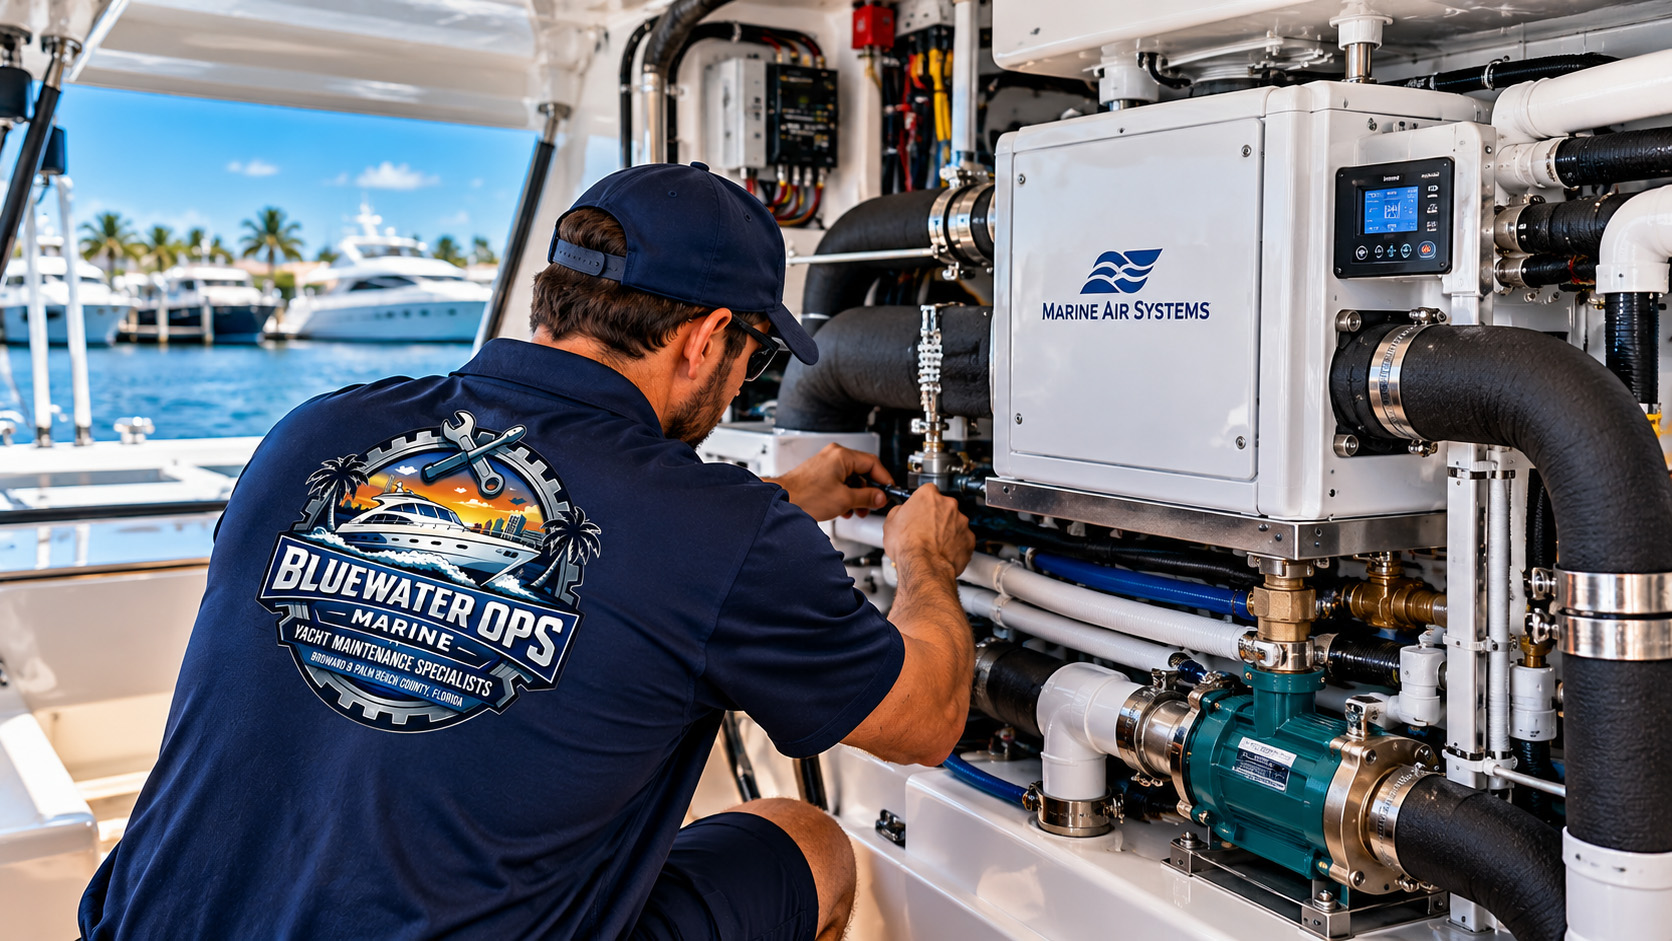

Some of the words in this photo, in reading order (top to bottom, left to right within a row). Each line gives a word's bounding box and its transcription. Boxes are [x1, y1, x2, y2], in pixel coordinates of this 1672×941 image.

[1042, 302, 1098, 320] MARINE
[1102, 301, 1130, 320] AIR
[1134, 300, 1210, 320] SYSTEMS
[271, 544, 476, 629] BLUEWATER
[476, 600, 564, 667] OPS
[350, 608, 454, 651] MARINE
[294, 624, 332, 647] YACHT
[331, 634, 415, 672] MAINTENANCE
[415, 659, 493, 697] SPECIALISTS
[353, 663, 375, 678] PALM
[399, 677, 430, 697] COUNTY,
[431, 688, 464, 708] FLORIDA
